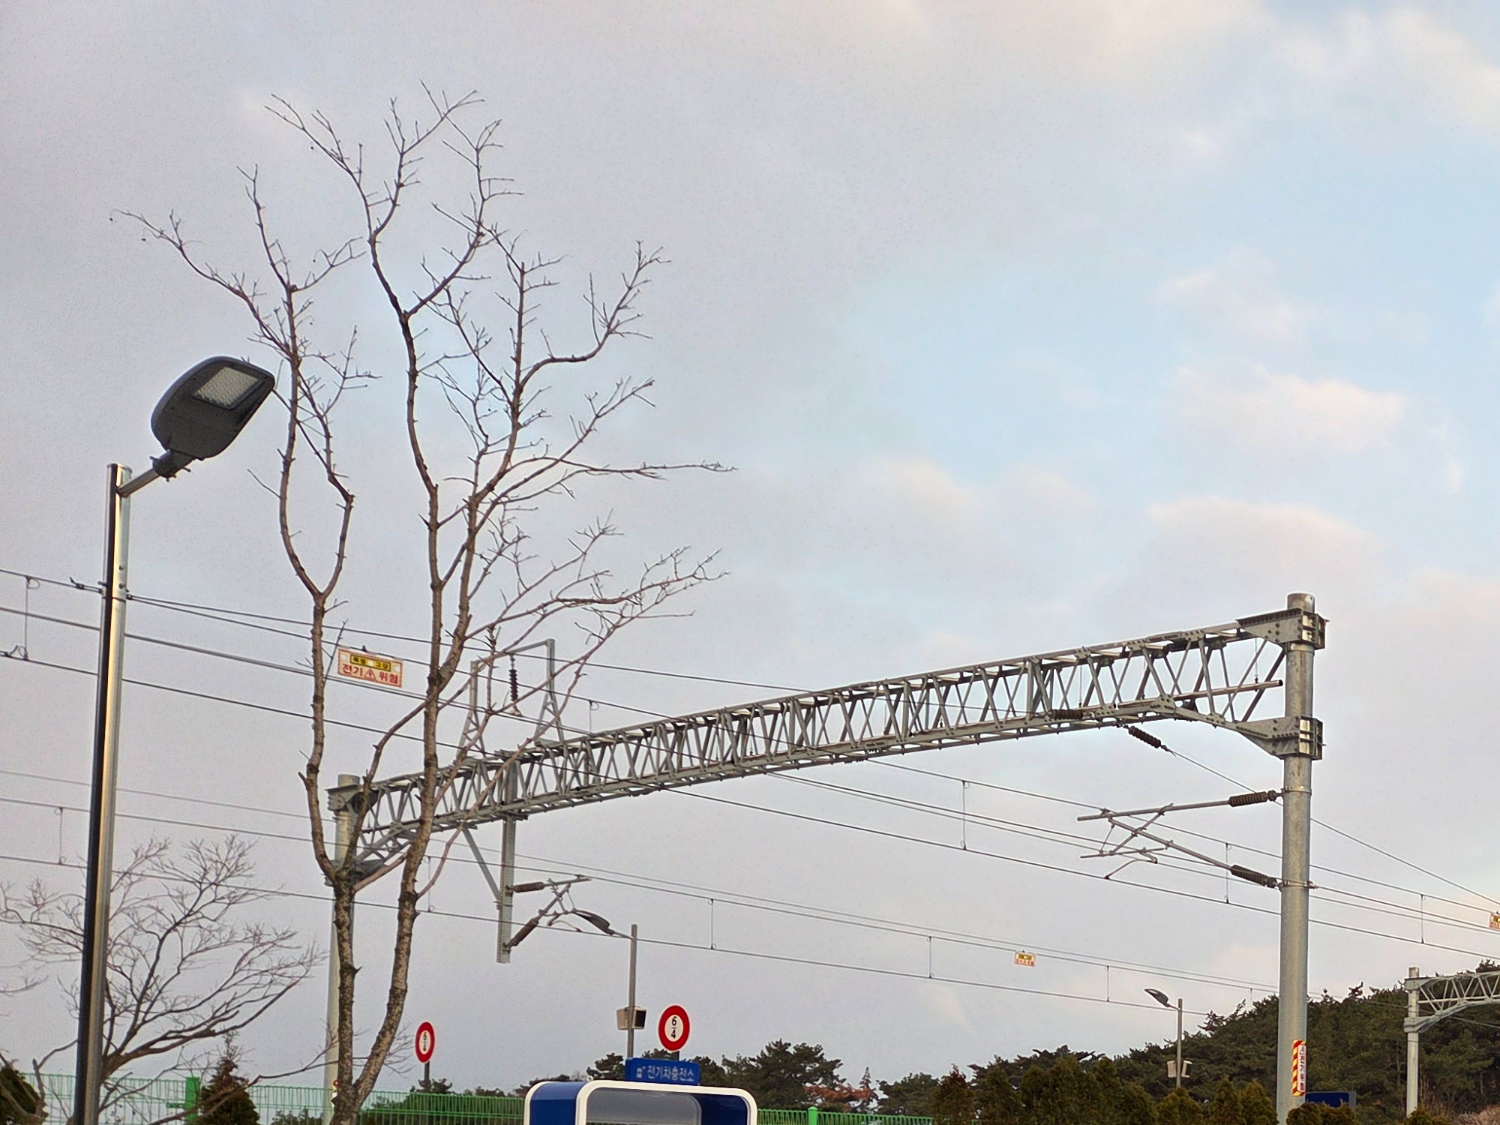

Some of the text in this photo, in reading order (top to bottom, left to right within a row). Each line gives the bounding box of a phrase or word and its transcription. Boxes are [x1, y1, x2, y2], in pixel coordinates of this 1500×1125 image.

[342, 663, 398, 684] 전기 위험
[671, 1015, 677, 1026] 6
[670, 1029, 676, 1039] 4
[647, 1065, 695, 1082] 전기차충전소
